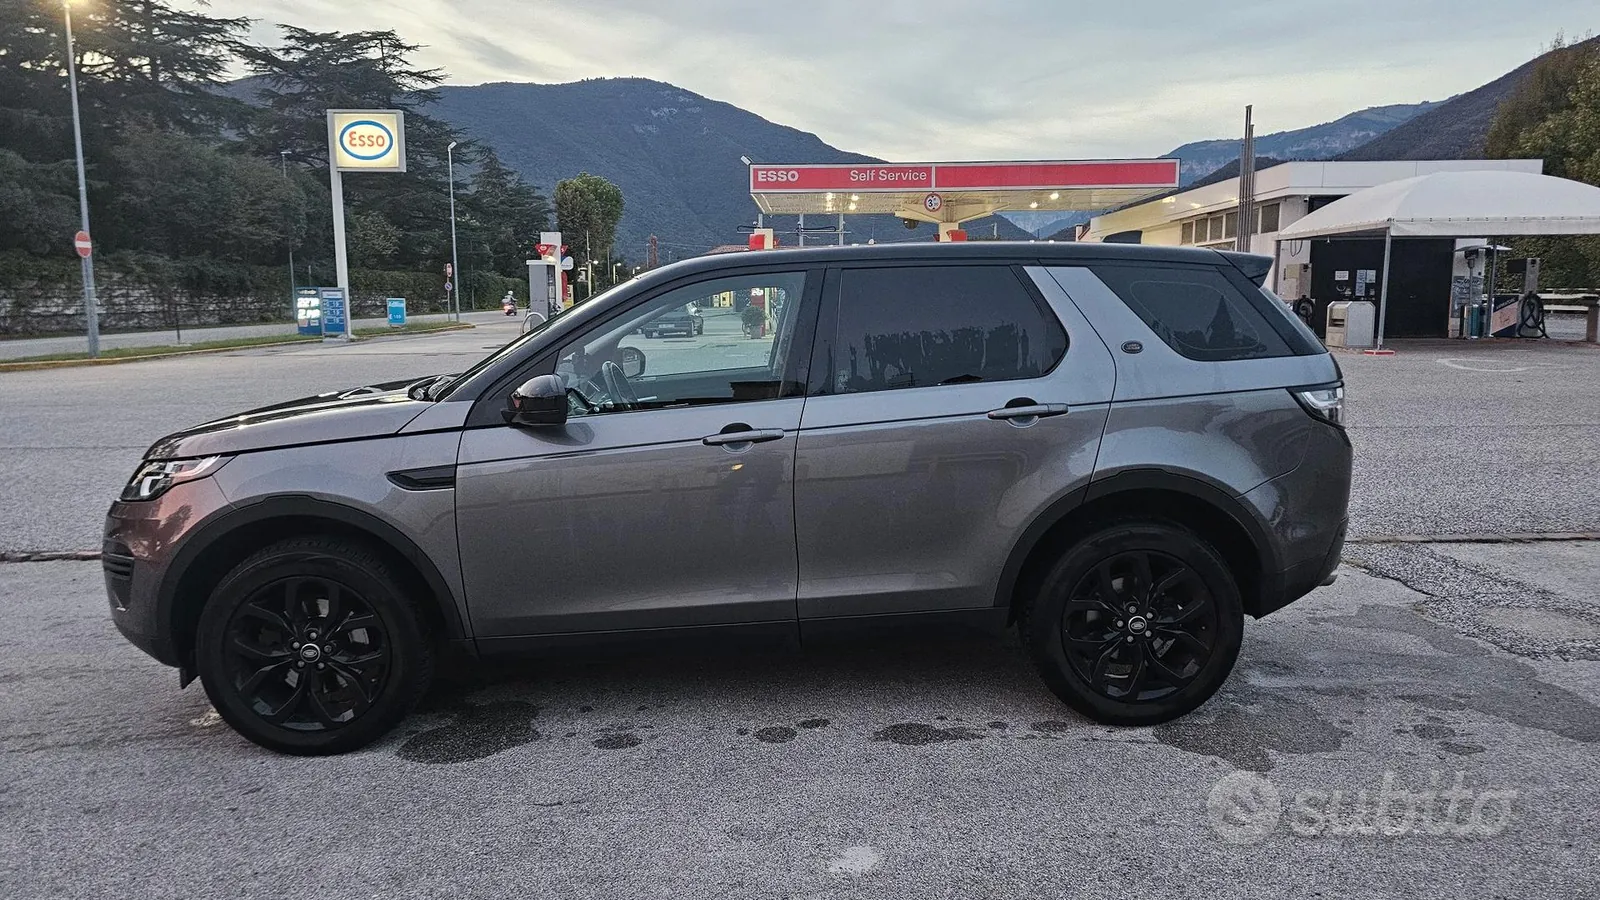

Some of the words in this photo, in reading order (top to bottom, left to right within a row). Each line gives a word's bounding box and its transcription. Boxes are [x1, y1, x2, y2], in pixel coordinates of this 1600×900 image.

[757, 170, 799, 182] ESSO
[849, 169, 876, 181] Self
[878, 169, 927, 181] Service
